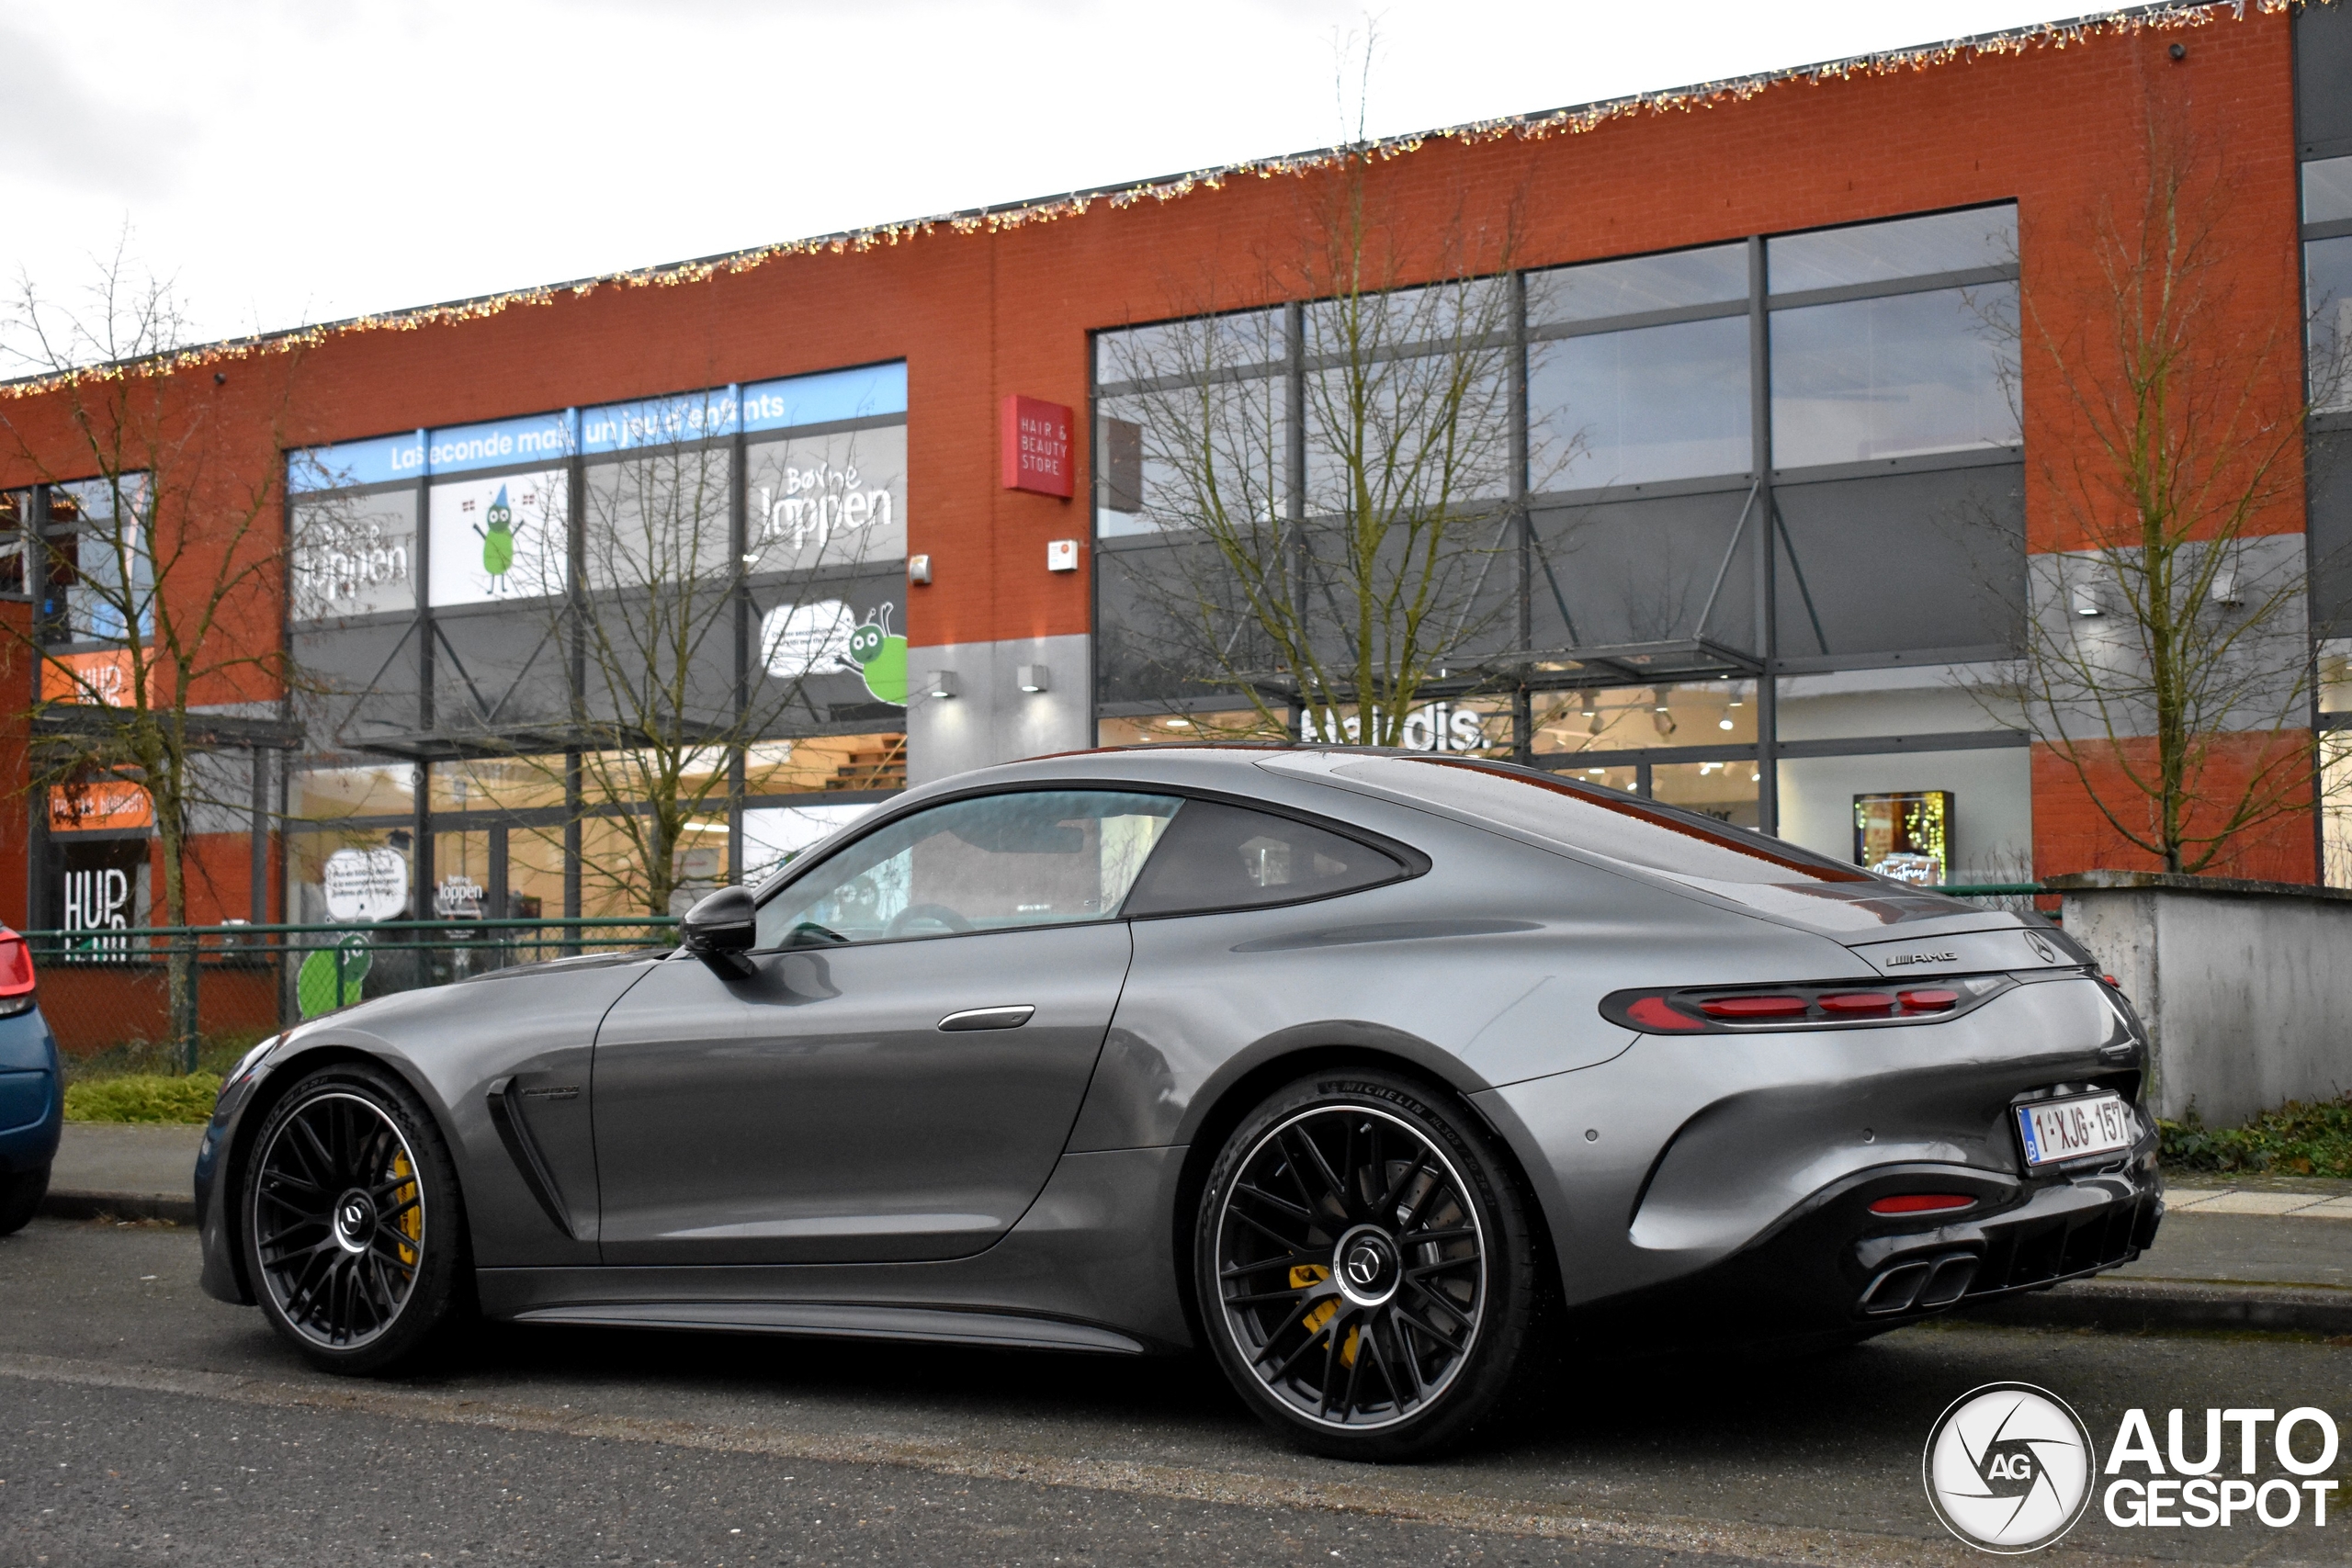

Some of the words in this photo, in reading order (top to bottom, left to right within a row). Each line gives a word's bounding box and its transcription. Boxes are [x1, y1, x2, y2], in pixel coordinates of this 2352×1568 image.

[391, 446, 413, 470] La
[416, 431, 514, 465] seconde
[585, 420, 616, 444] un
[619, 412, 660, 447] jeu
[1021, 418, 1052, 437] HAIR
[1059, 424, 1067, 441] &
[1022, 435, 1068, 458] BEAUTY
[1023, 454, 1059, 476] STORE
[761, 487, 892, 550] loppen
[65, 868, 128, 931] HUP
[439, 880, 483, 905] loppen
[1910, 951, 1958, 964] AMG
[1342, 1081, 1425, 1115] MICHELIN
[2035, 1100, 2124, 1153] 1-XJG-157
[2027, 1140, 2038, 1158] B
